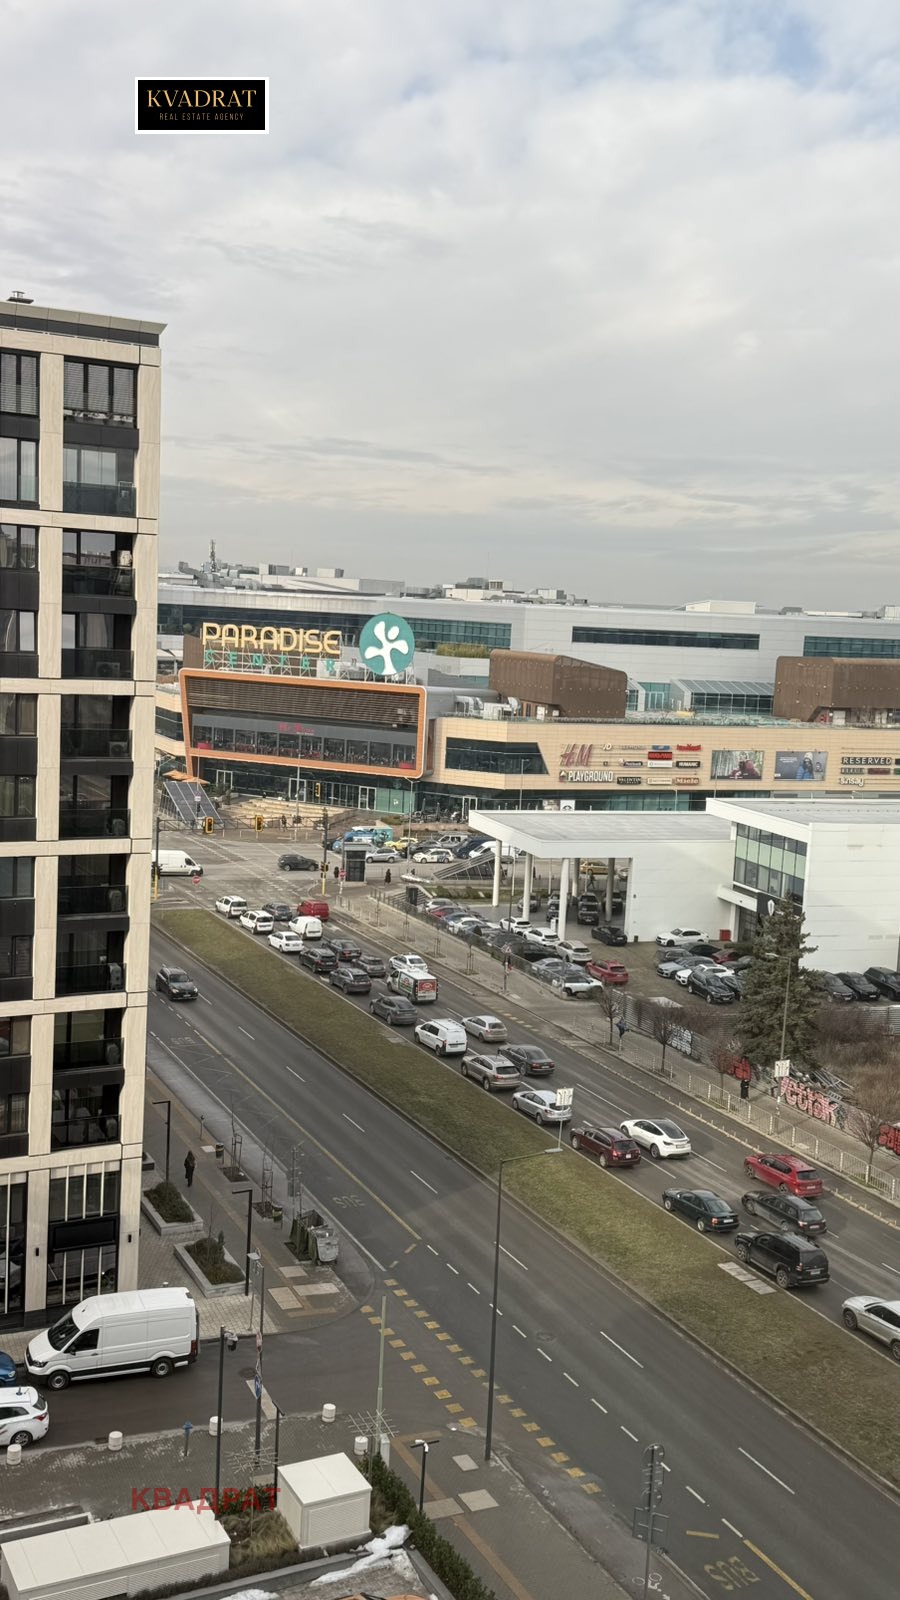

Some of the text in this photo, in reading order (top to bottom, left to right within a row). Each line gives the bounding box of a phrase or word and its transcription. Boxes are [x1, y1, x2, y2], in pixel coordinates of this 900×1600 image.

[202, 621, 342, 655] PARADISE
[204, 649, 337, 672] CENTER
[842, 757, 892, 765] RESERVED
[568, 770, 614, 782] PLAYGROUND
